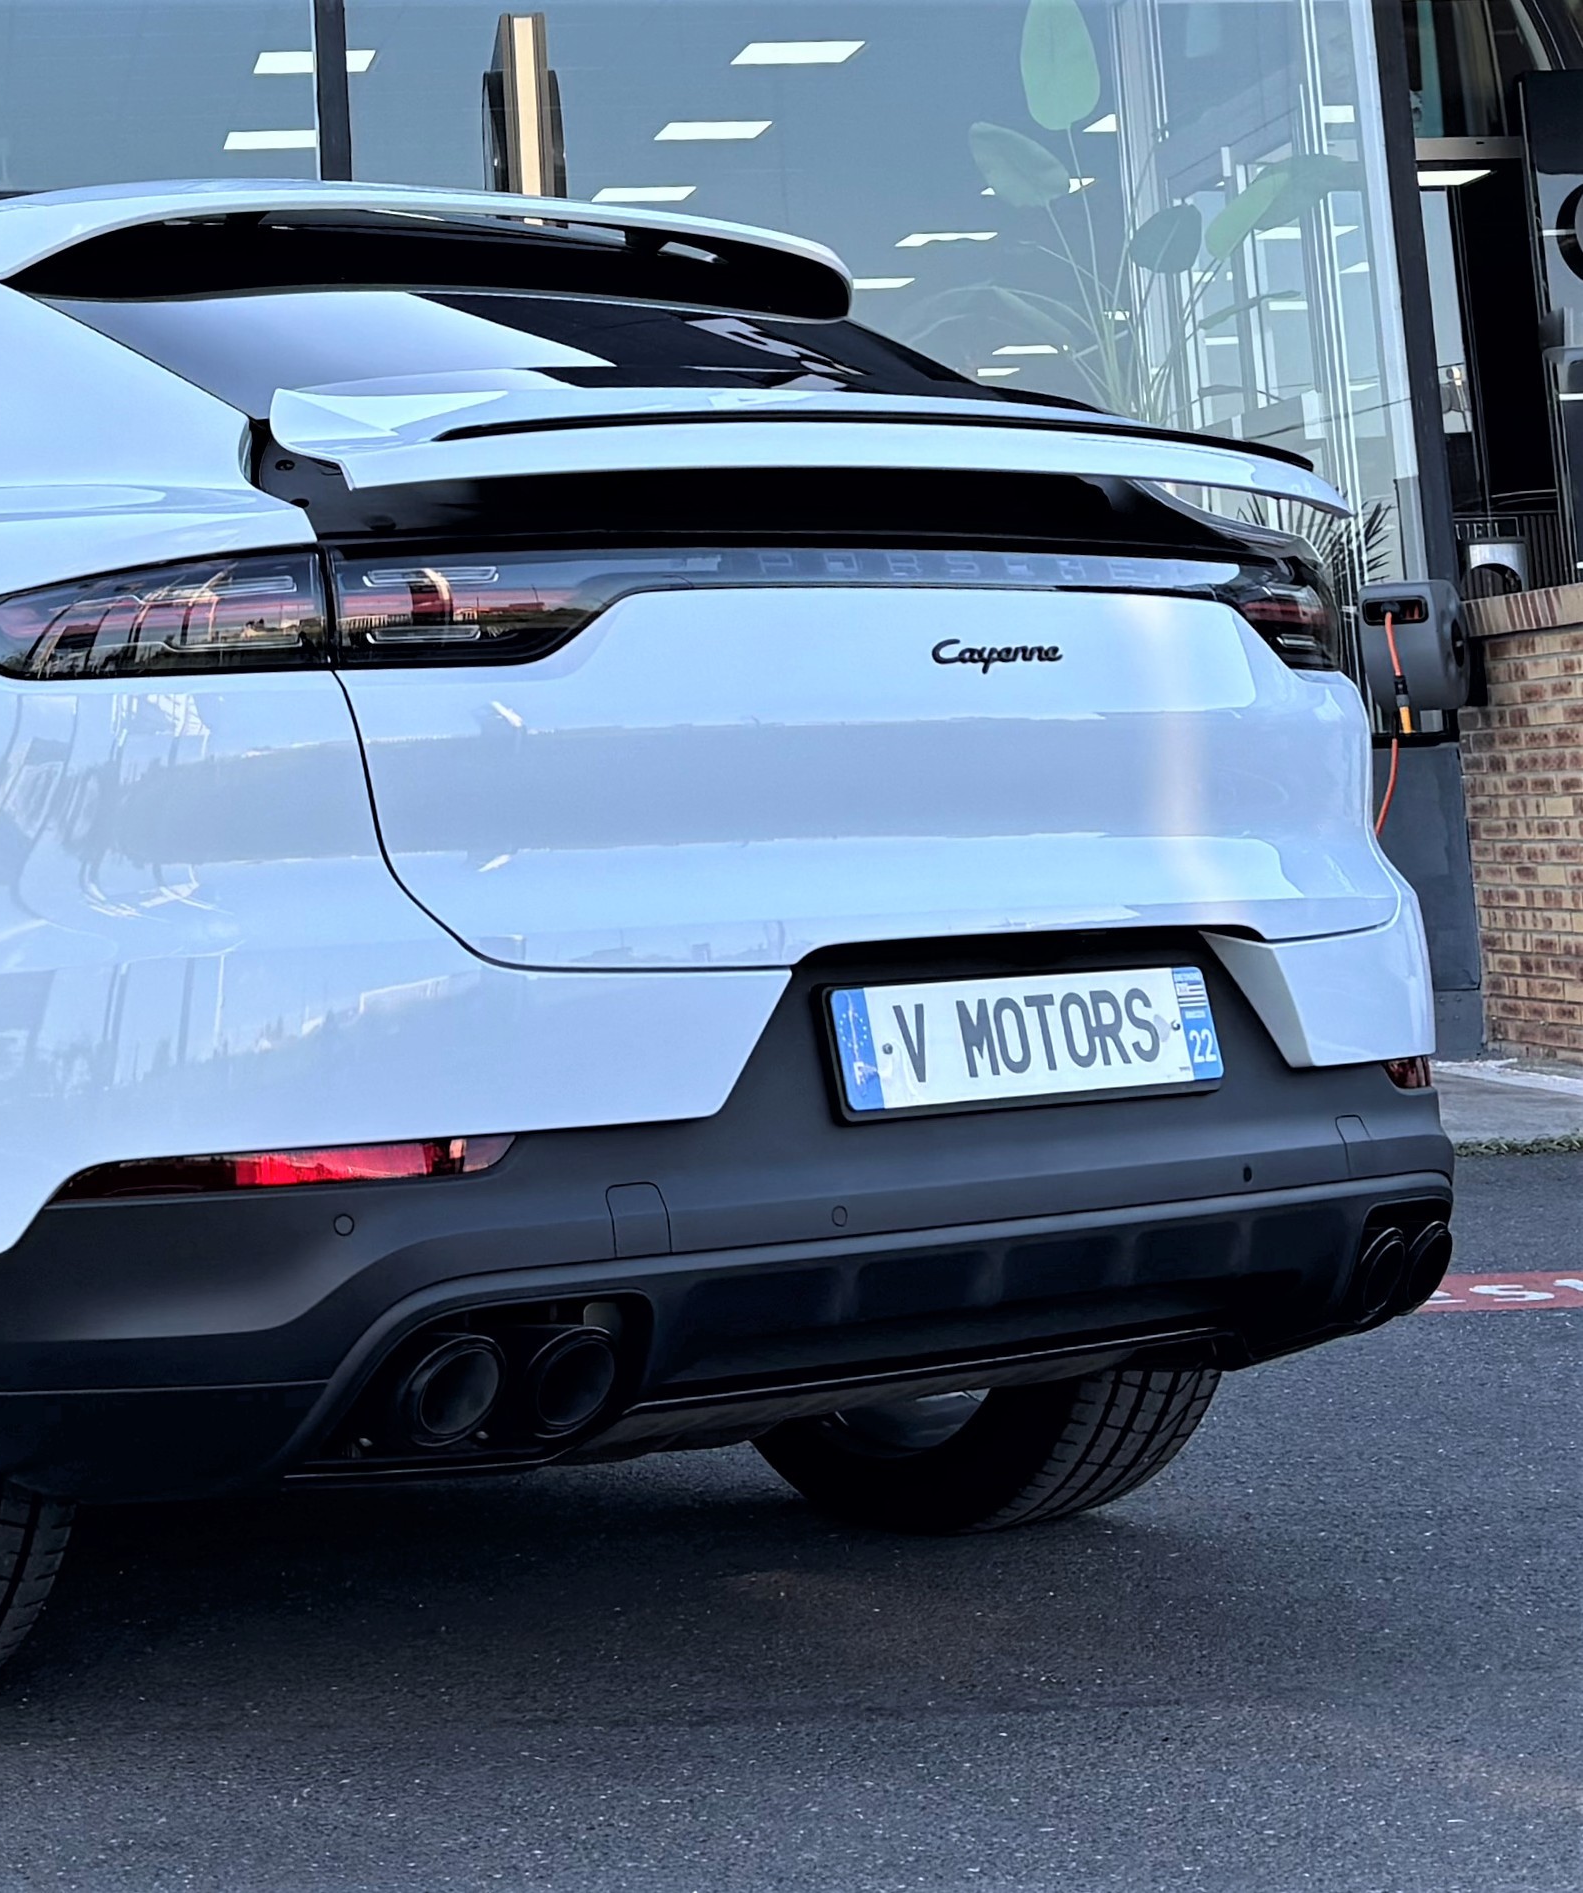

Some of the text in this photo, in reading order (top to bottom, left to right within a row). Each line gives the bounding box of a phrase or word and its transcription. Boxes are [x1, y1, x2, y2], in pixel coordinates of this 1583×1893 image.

[758, 552, 1160, 583] PORSCHE
[931, 638, 1064, 674] Cayenne
[892, 987, 1161, 1084] V MOTORS
[1189, 1027, 1218, 1064] 22
